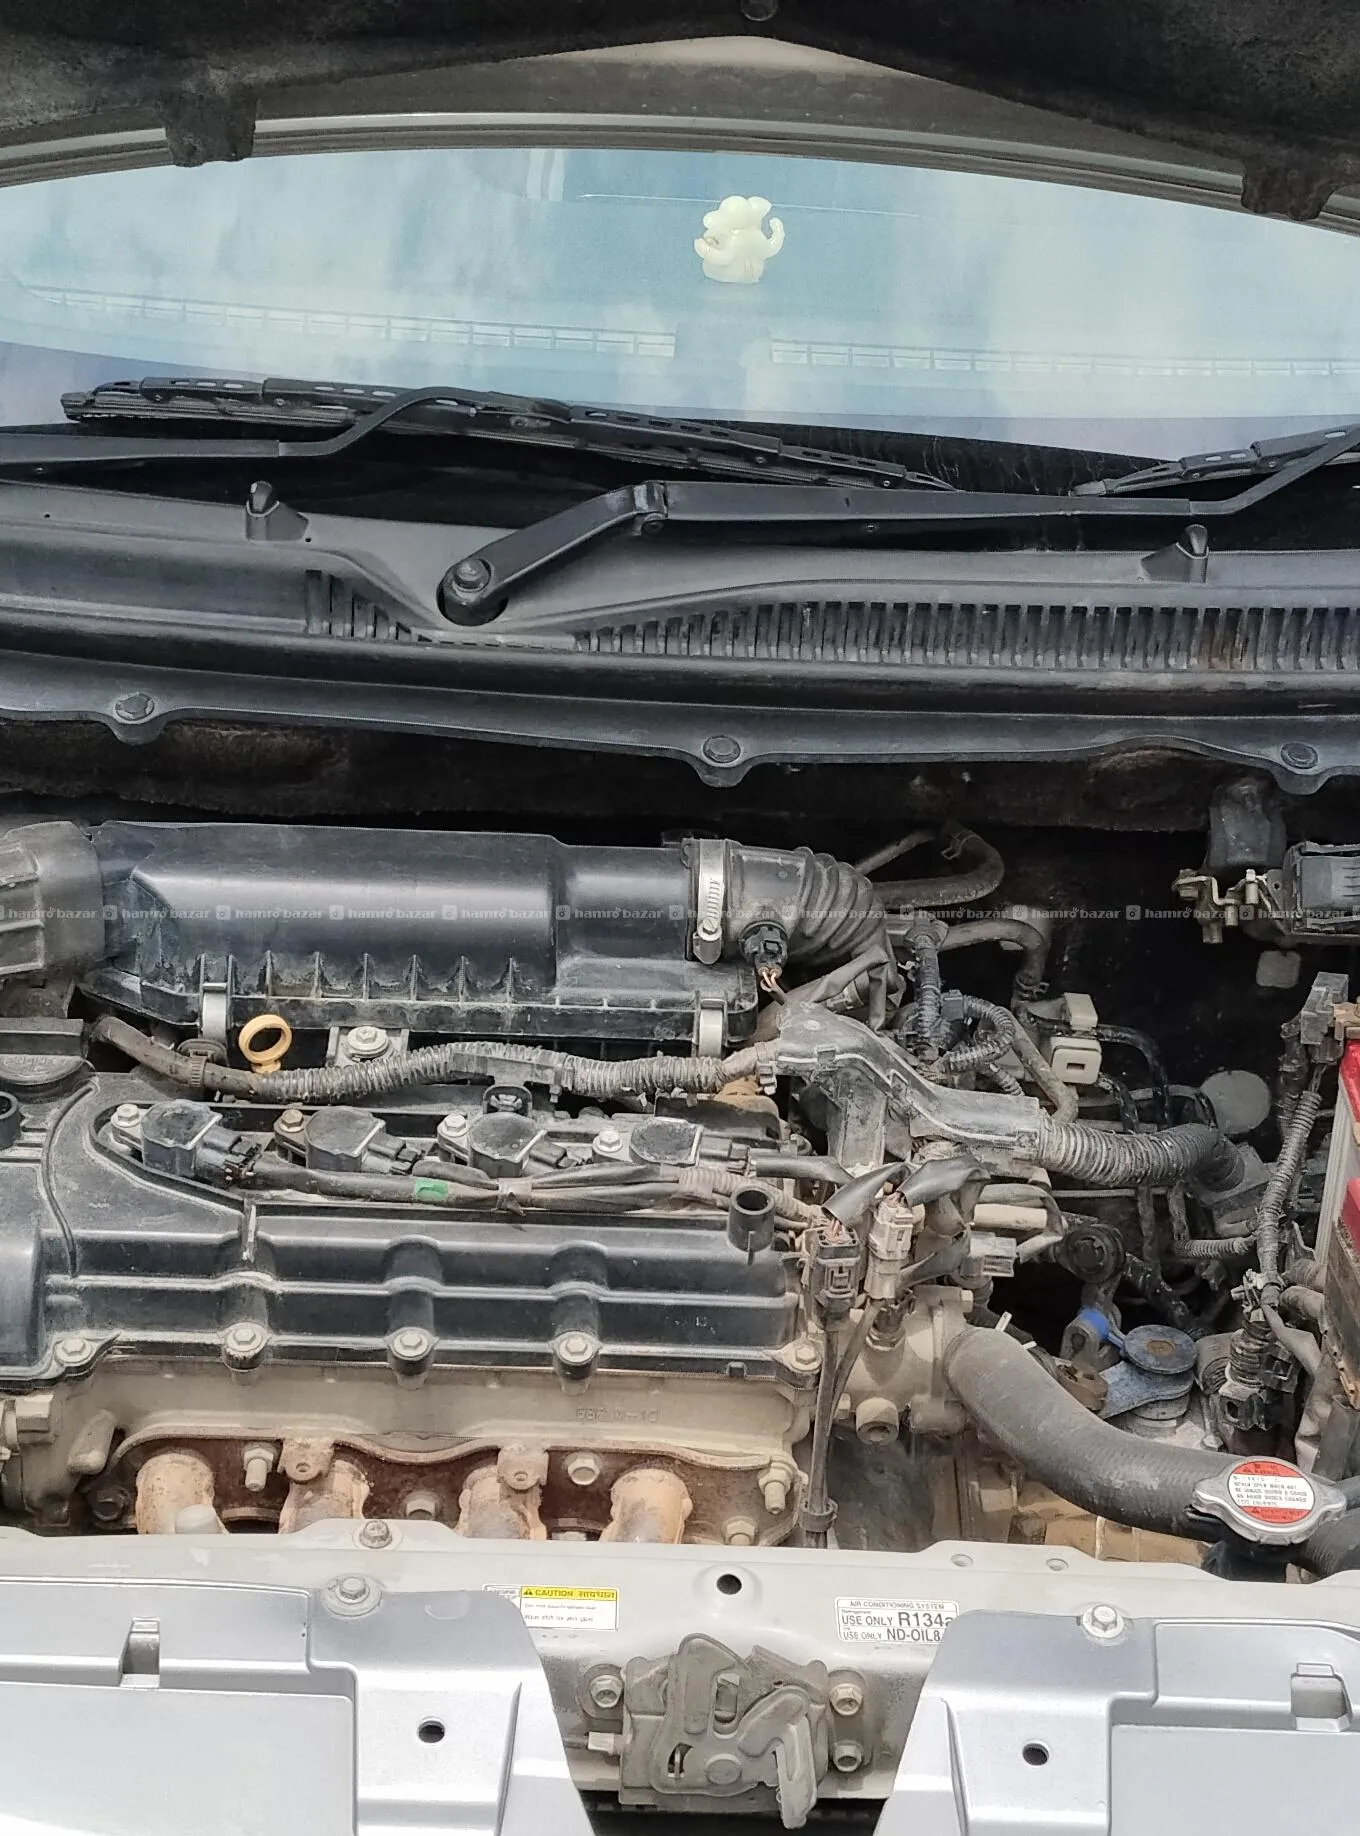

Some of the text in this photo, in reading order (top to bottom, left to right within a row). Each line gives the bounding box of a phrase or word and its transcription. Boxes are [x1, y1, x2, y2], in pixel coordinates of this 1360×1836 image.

[535, 1589, 574, 1597] CAUTION
[863, 1601, 915, 1609] CONDITIONING
[916, 1602, 945, 1610] SYSTEM
[842, 1615, 862, 1626] USE
[865, 1615, 893, 1627] ONLY
[843, 1631, 859, 1640] USE
[861, 1631, 882, 1640] ONLY
